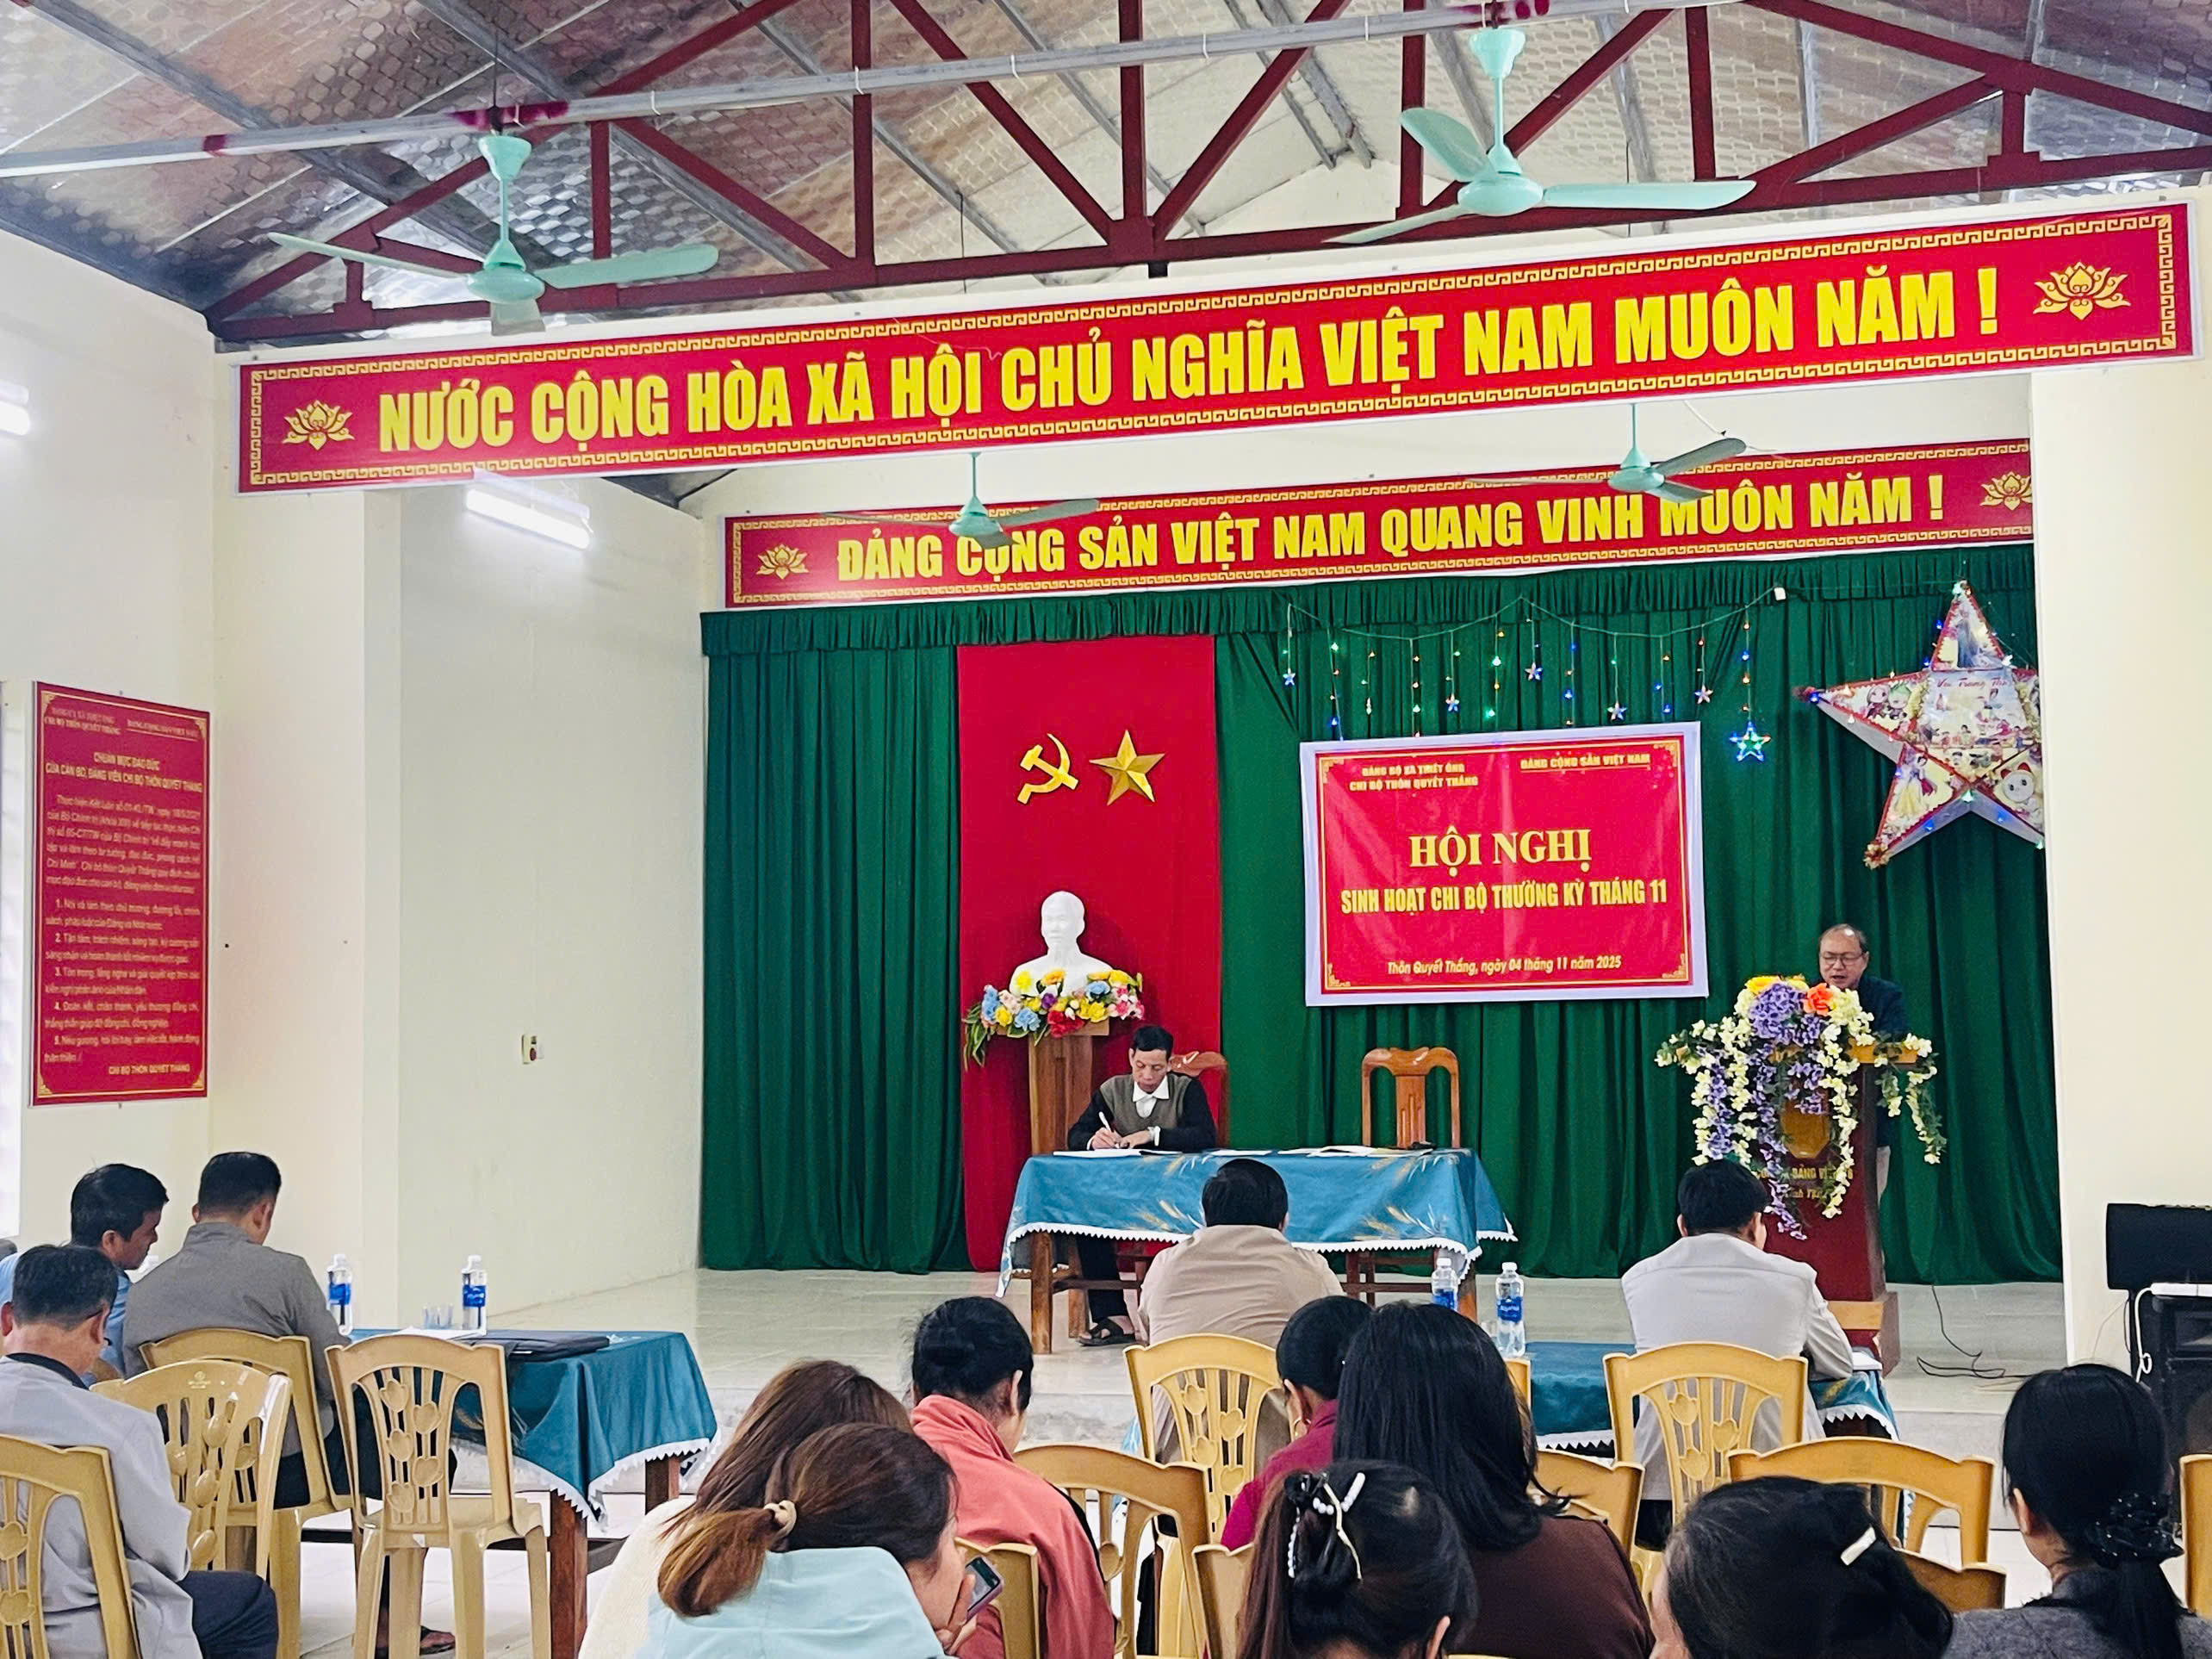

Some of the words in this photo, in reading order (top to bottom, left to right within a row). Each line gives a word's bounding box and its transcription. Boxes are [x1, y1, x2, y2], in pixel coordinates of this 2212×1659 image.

[380, 378, 514, 453] NƯỚC
[531, 370, 669, 452] CỘNG
[687, 359, 792, 433] HÒA
[806, 351, 875, 426] XÃ
[891, 344, 982, 428] HỘI
[999, 326, 1112, 411] CHỦ
[1133, 320, 1304, 401] NGHĨA
[1320, 306, 1445, 394] VIỆT
[1463, 301, 1593, 376] NAM
[1614, 276, 1794, 364] MUÔN
[1816, 264, 1955, 348] NĂM
[1978, 267, 1998, 335] !
[836, 529, 943, 582] ĐẢNG
[1078, 514, 1158, 570] SẢN
[1171, 512, 1260, 573] VIỆT
[1274, 512, 1365, 559] NAM
[1380, 501, 1523, 553] QUANG
[1537, 494, 1643, 544] VINH
[1660, 478, 1793, 537] MUÔN
[1810, 473, 1912, 528] NĂM
[1928, 475, 1944, 520] !
[1408, 824, 1482, 877] HỘI
[1491, 829, 1592, 873] NGHỊ
[1340, 888, 1380, 914] SINH
[1383, 887, 1426, 916] HOẠT
[1430, 885, 1460, 911] CHI
[1464, 881, 1488, 915] BỘ
[1491, 879, 1559, 909] THƯỜNG
[1563, 878, 1585, 906] KỲ
[1588, 876, 1646, 905] THÁNG
[1650, 879, 1668, 904] 11
[1388, 960, 1411, 974] Thôn
[1481, 958, 1507, 975] ngày
[1524, 956, 1554, 973] tháng
[1556, 956, 1568, 970] 11
[1570, 955, 1594, 970] năm
[1596, 955, 1622, 969] 2025
